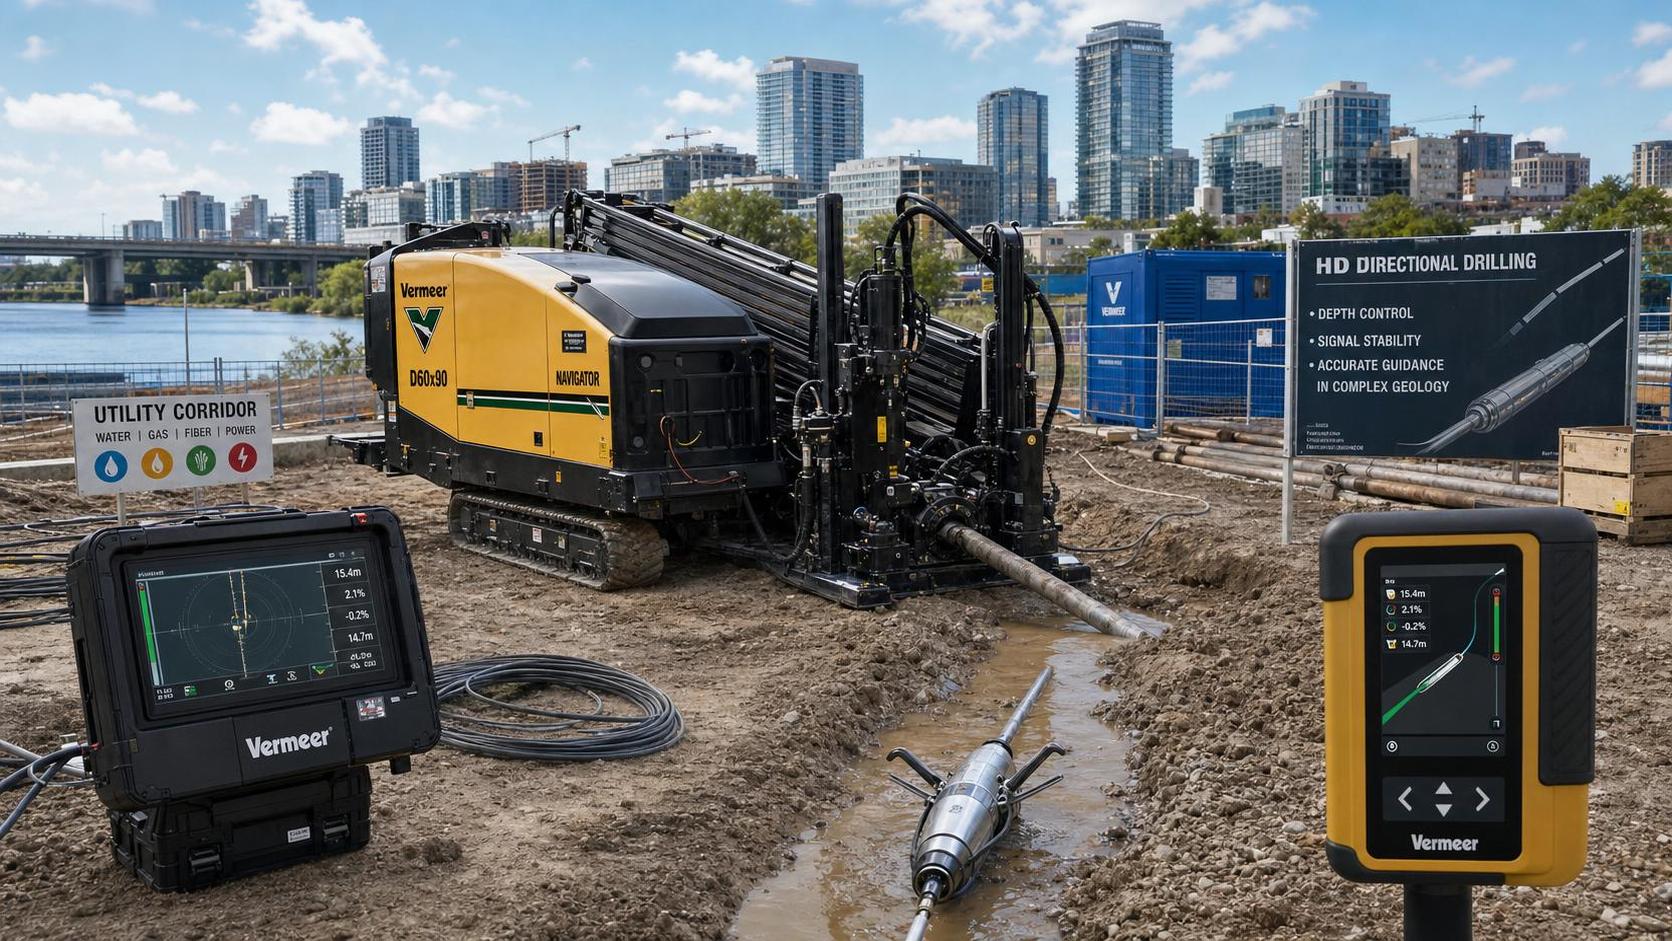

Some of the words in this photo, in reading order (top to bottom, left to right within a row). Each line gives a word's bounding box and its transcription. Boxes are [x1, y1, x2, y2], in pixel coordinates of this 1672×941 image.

[1315, 256, 1350, 275] HD
[1356, 254, 1459, 274] DIRECTIONAL
[1463, 252, 1537, 272] DRILLING
[400, 282, 448, 299] Vermeer
[1318, 308, 1355, 320] DEPTH
[1359, 307, 1414, 320] CONTROL
[1317, 335, 1360, 348] SIGNAL
[1363, 334, 1422, 348] STABILITY
[1317, 359, 1378, 372] ACCURATE
[1382, 358, 1445, 372] GUIDANCE
[409, 369, 448, 388] D60x90
[555, 370, 601, 387] NAVIGATOR
[1316, 380, 1328, 393] IN
[1332, 380, 1389, 393] COMPLEX
[1392, 380, 1450, 393] GEOLOGY
[94, 403, 166, 424] UTILITY
[173, 401, 257, 421] CORRIDOR
[95, 431, 131, 443] WATER
[148, 429, 169, 440] GAS
[184, 427, 212, 438] FIBER
[225, 425, 256, 436] POWER
[334, 568, 362, 580] 15.4m
[344, 588, 366, 600] 2.1%
[1400, 588, 1426, 599] 15.4m
[345, 611, 370, 621] -0.2%
[1401, 604, 1423, 615] 2.1%
[1401, 621, 1427, 632] -0.2%
[348, 632, 374, 644] 14.7m
[1401, 639, 1427, 649] 14.7m
[245, 728, 330, 759] Vermeer
[1411, 833, 1479, 851] Vermeer
